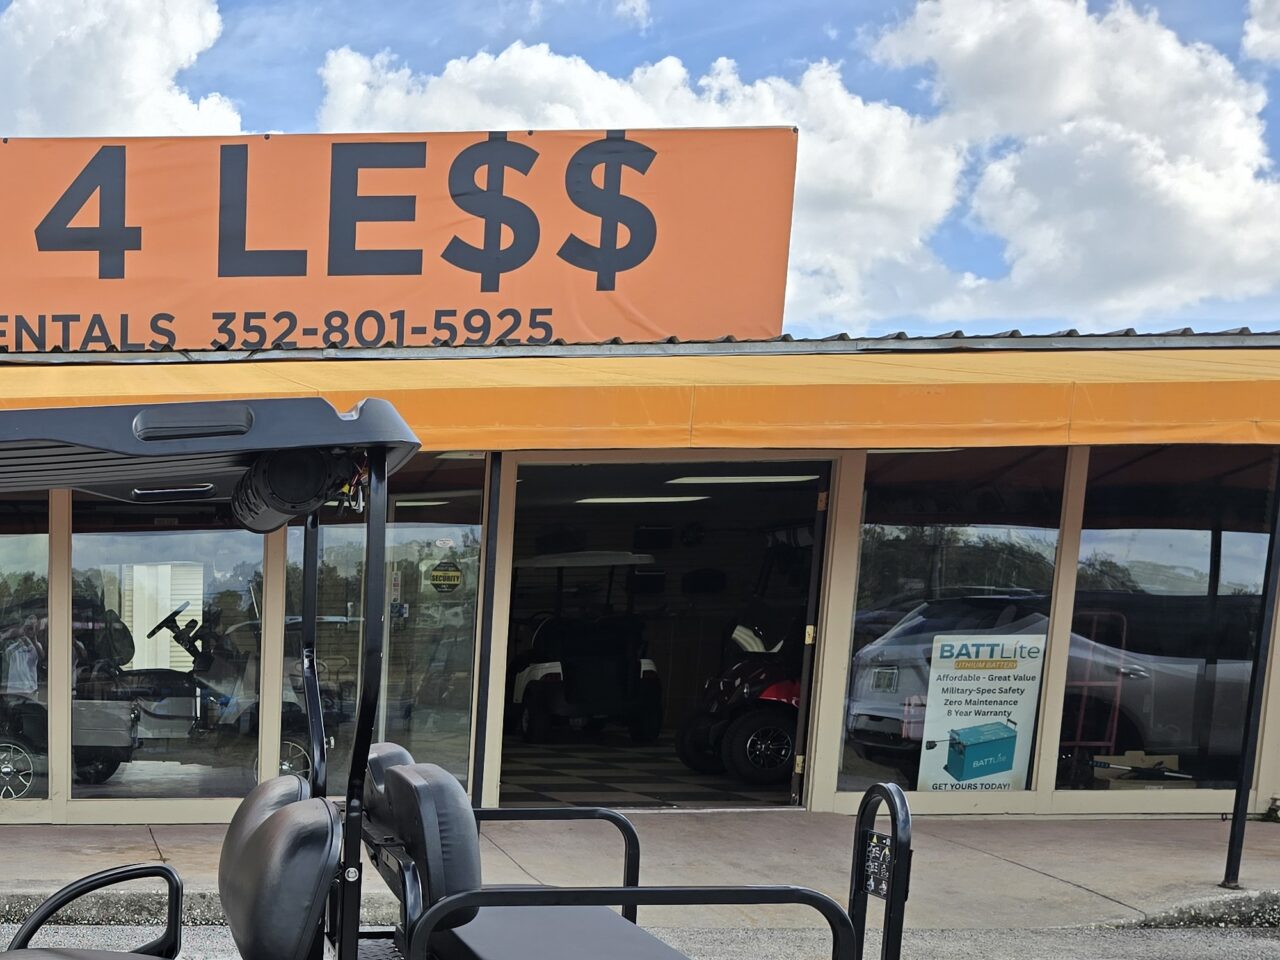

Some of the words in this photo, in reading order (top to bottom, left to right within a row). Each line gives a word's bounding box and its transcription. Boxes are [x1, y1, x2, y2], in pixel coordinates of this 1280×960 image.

[34, 144, 142, 280] 4
[217, 129, 658, 293] LE$$
[210, 308, 553, 349] 352-801-5925
[939, 641, 1040, 659] BATTLite
[986, 660, 1017, 669] BATTERY
[936, 674, 981, 682] Affordable
[987, 674, 1011, 682] Great
[1012, 674, 1037, 682] Value
[941, 687, 997, 696] Military-Spec
[997, 687, 1025, 696] Safety
[964, 698, 1019, 706] Maintenance
[974, 709, 1013, 718] Warranty
